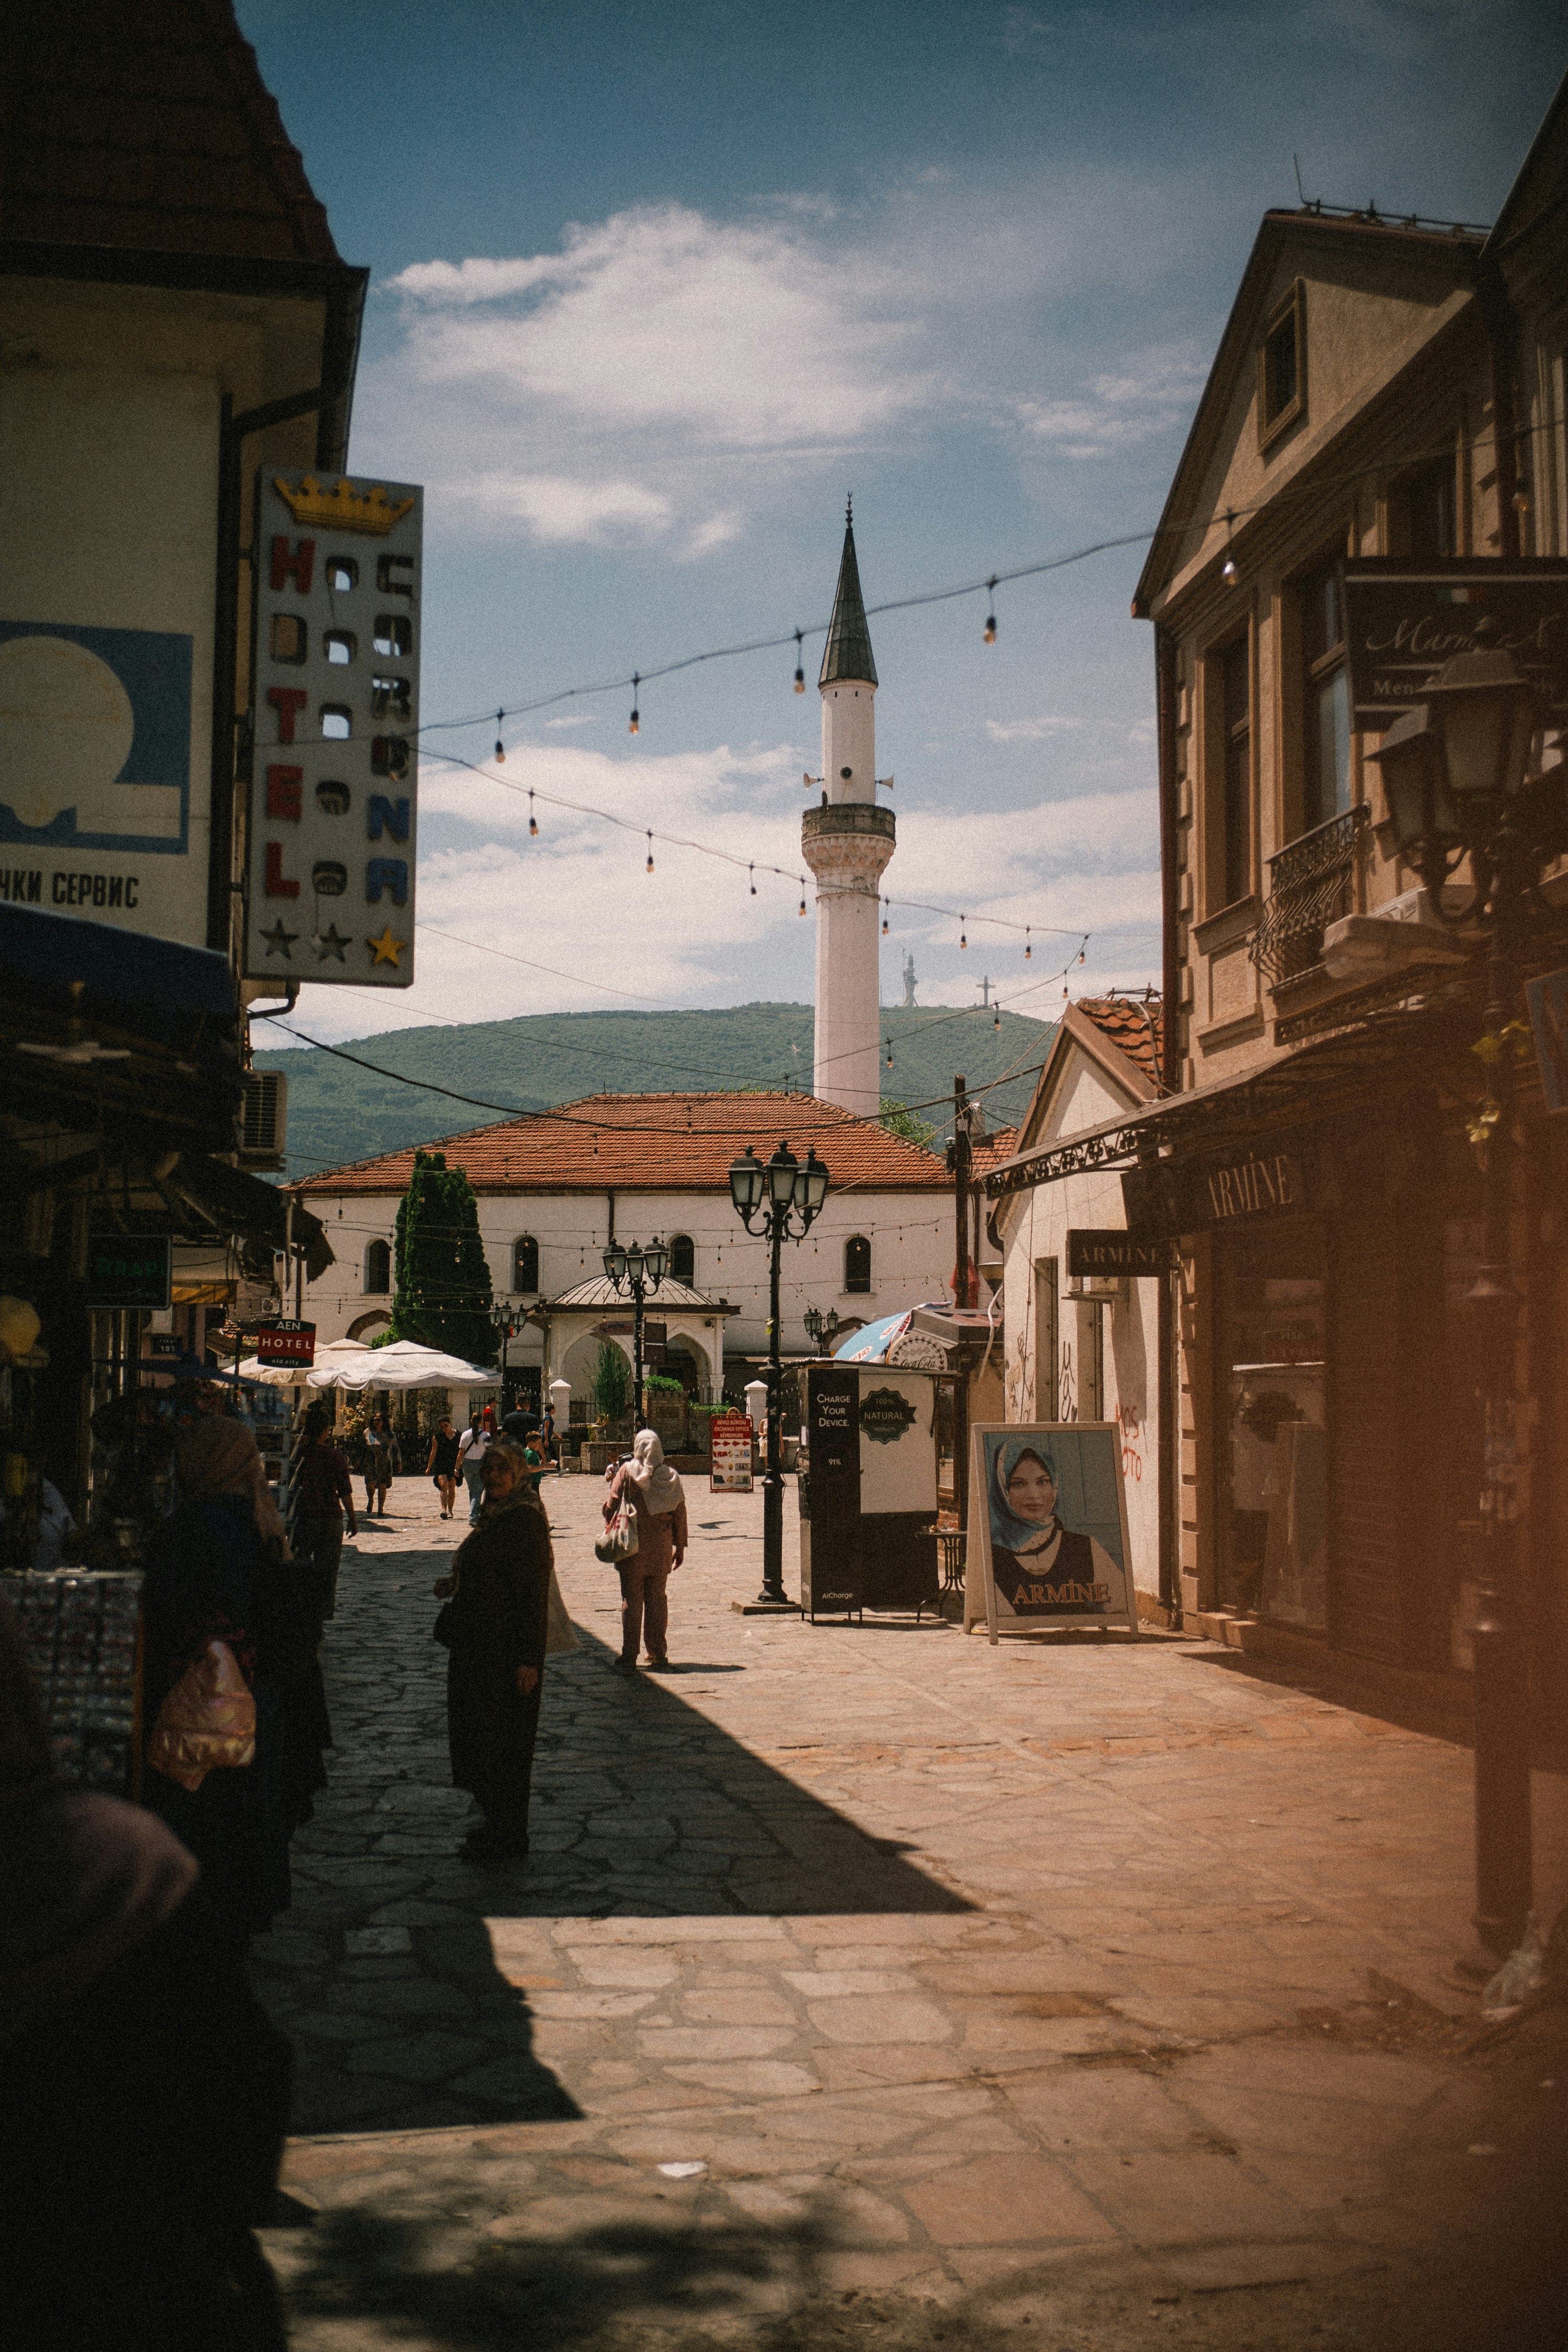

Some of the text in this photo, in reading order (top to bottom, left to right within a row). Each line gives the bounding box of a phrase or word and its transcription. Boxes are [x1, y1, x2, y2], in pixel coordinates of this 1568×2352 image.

[52, 872, 139, 908] СЕРВИС
[276, 1320, 301, 1331] AEN
[262, 1338, 311, 1350] HOTEL
[864, 1412, 904, 1420] NATURAL
[1012, 1578, 1111, 1605] ARMİNE
